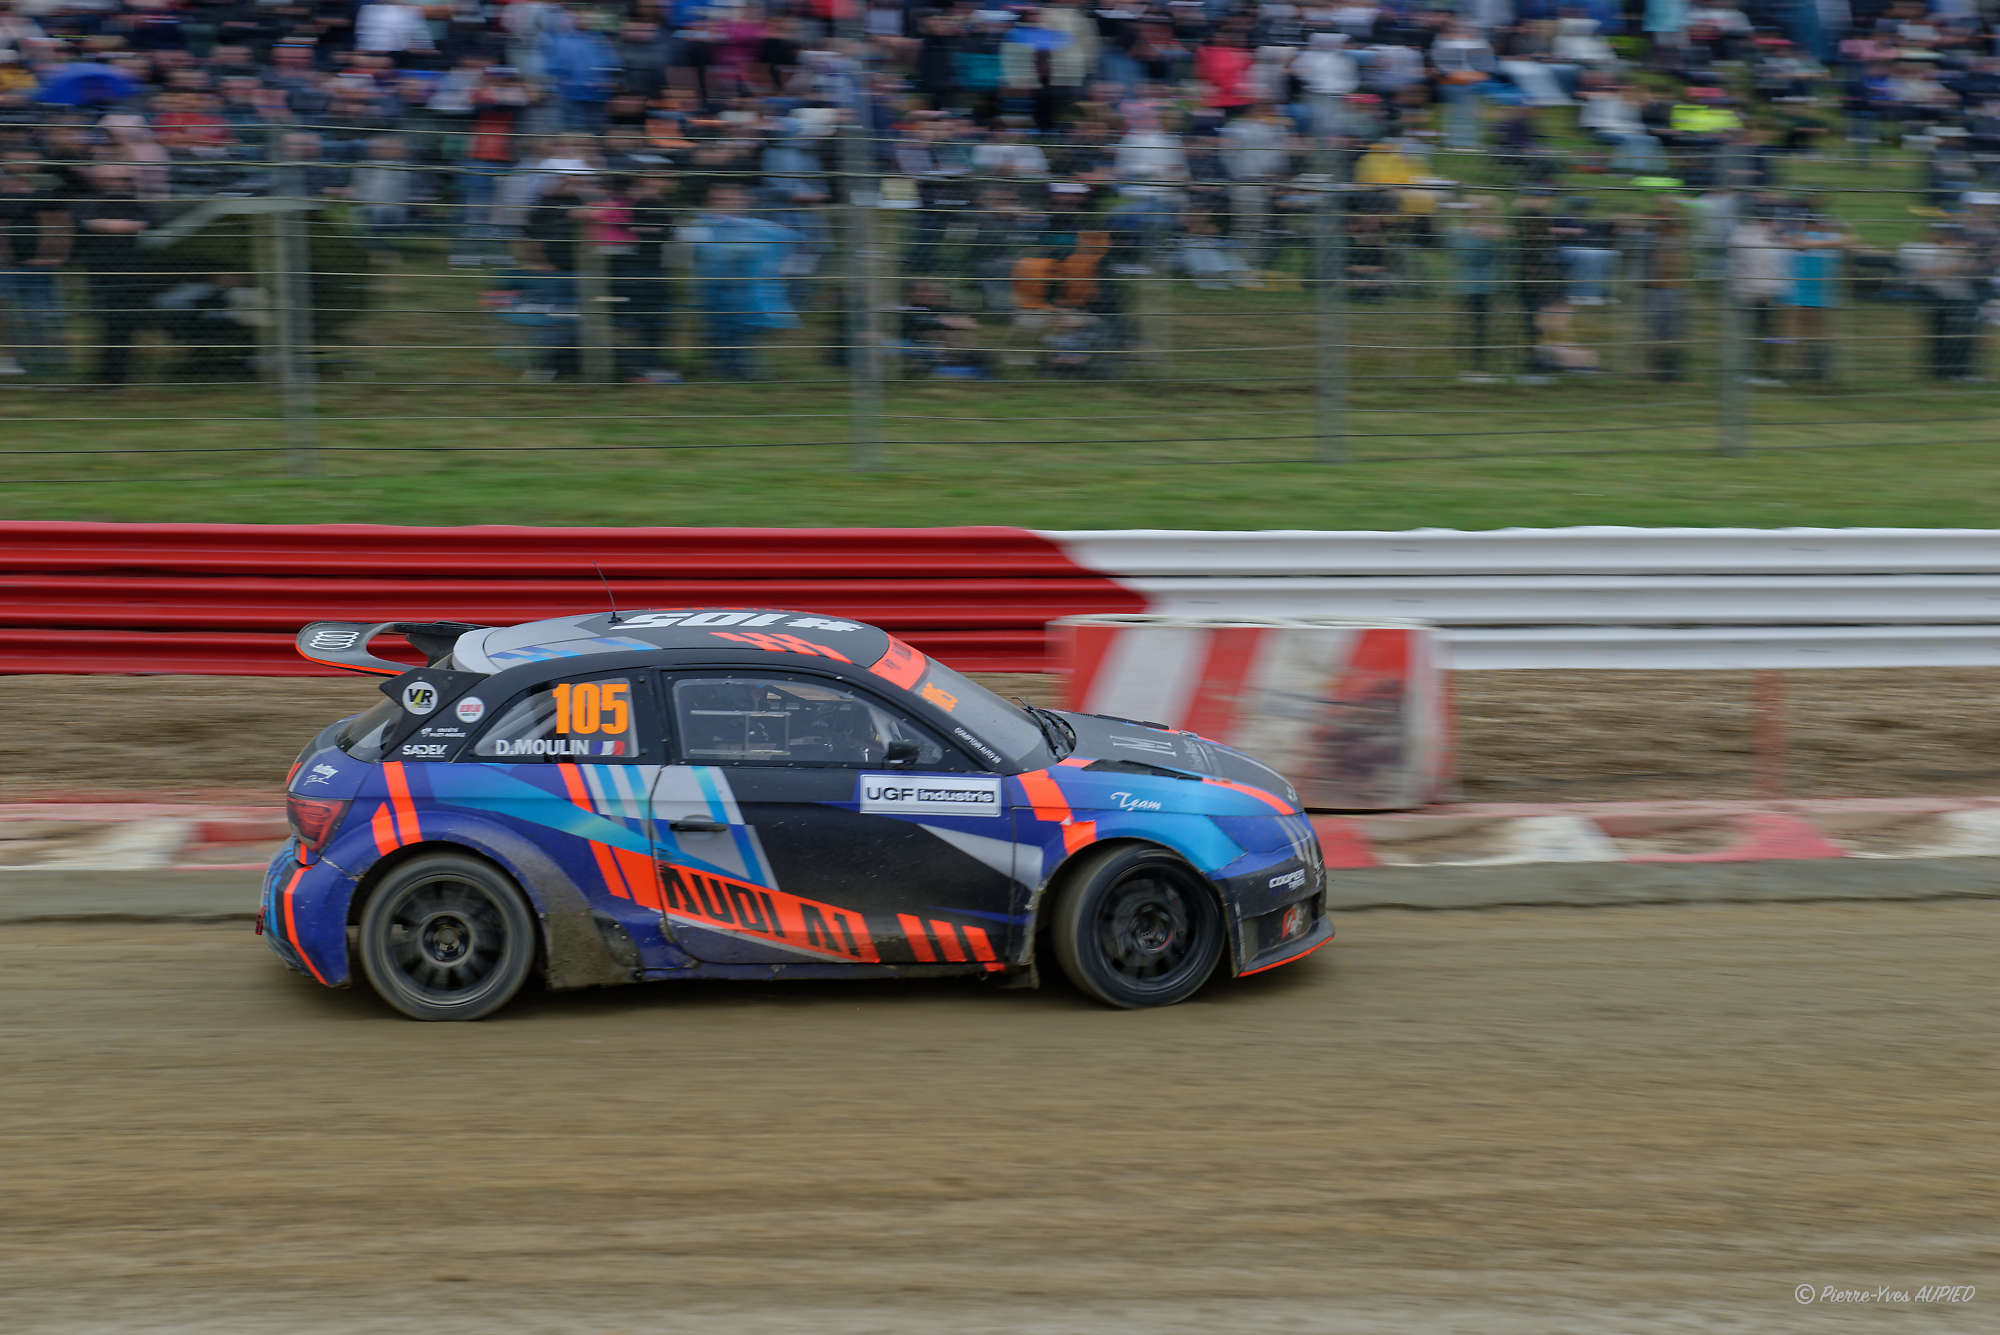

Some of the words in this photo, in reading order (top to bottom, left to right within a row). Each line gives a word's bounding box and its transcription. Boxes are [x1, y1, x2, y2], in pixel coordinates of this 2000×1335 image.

[551, 683, 629, 734] 105
[495, 739, 590, 755] D.MOULIN
[866, 787, 914, 801] UGF
[919, 789, 994, 802] industrie
[1110, 791, 1162, 811] Team
[658, 864, 786, 938] AUDI
[799, 902, 861, 958] A1
